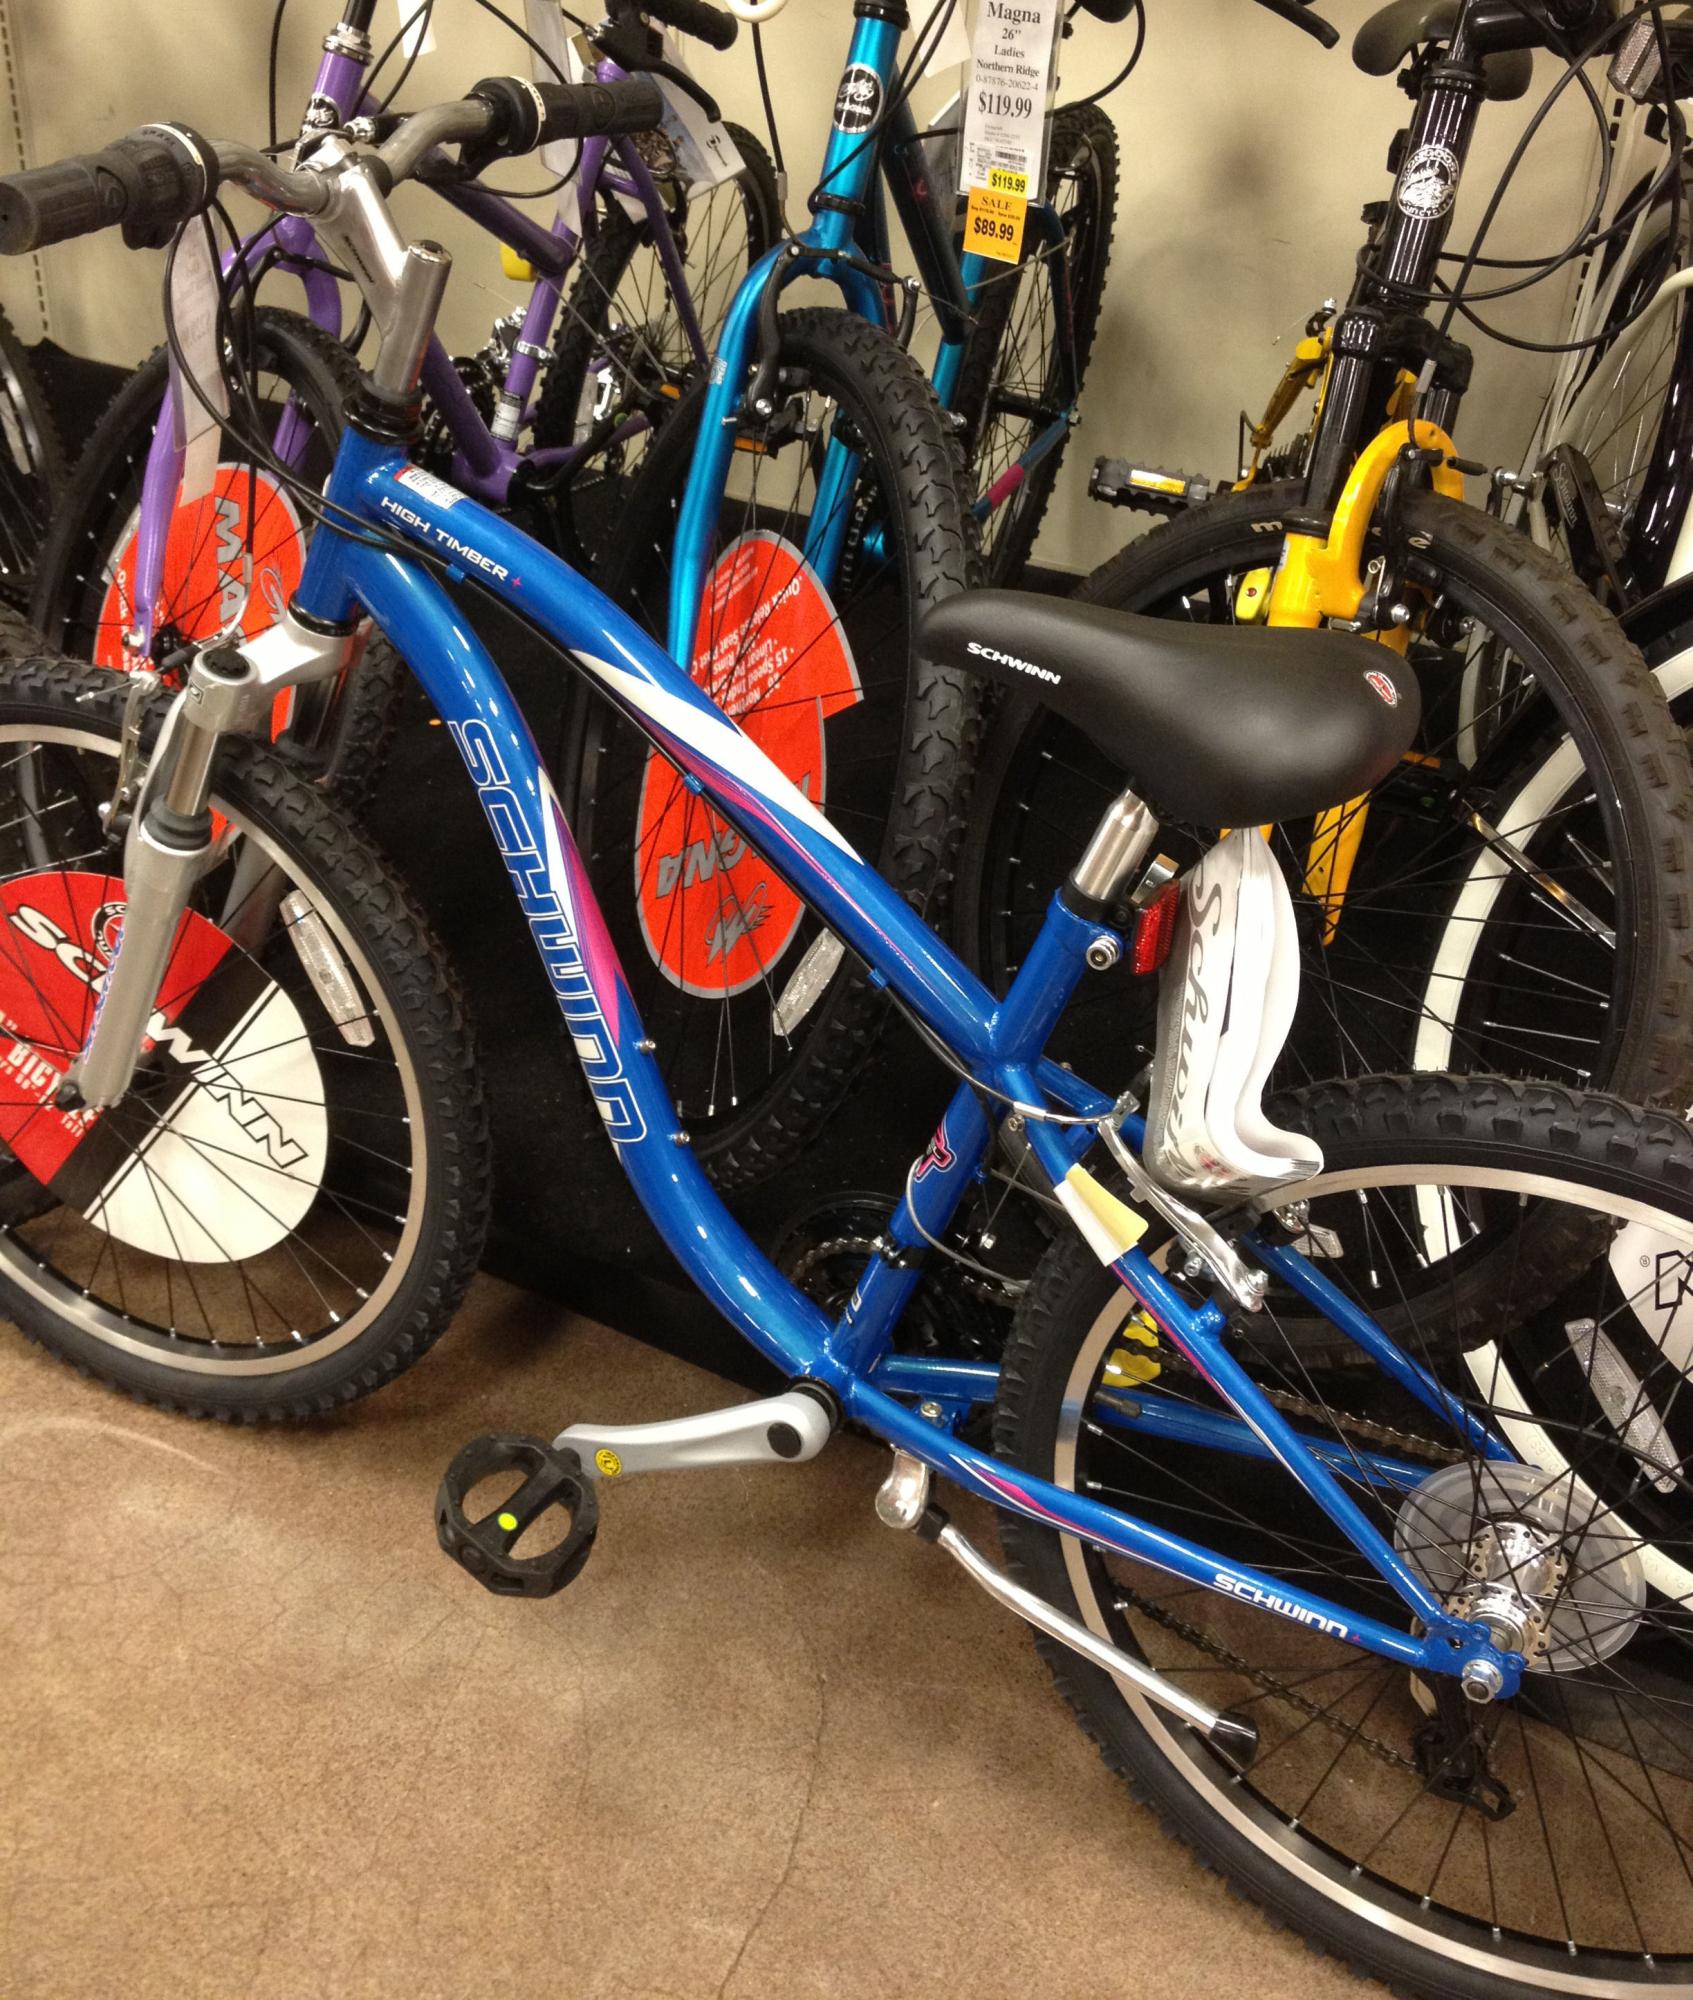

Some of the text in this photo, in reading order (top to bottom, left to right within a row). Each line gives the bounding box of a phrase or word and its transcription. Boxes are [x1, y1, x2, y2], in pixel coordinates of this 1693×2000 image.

[986, 1, 1041, 25] Magna
[994, 44, 1025, 58] Ladies
[976, 59, 1040, 78] Northern Ridge
[978, 91, 1032, 119] $119.99
[992, 173, 1026, 193] $119.99
[981, 196, 1013, 212] SALE
[974, 216, 1014, 241] $89.99
[380, 496, 509, 581] HIGH TIMBER
[771, 578, 801, 610] Quick
[740, 602, 771, 634] Release
[720, 630, 740, 652] Seat
[776, 647, 788, 668] 15
[966, 641, 1062, 686] SCHWINN
[748, 657, 774, 685] Speed
[447, 717, 648, 1148] SCHWINN
[1214, 1572, 1349, 1640] SCHWINN
